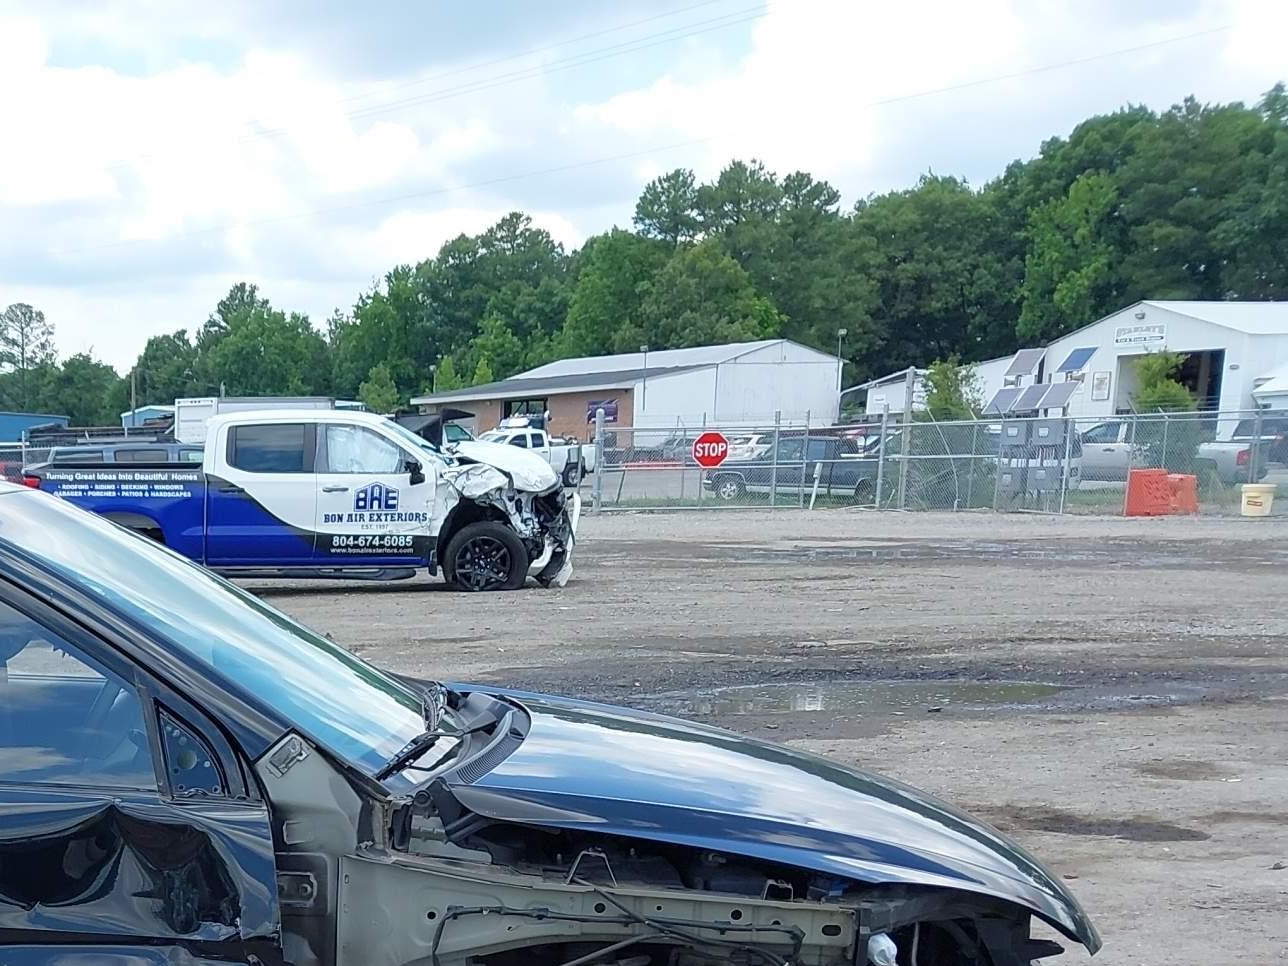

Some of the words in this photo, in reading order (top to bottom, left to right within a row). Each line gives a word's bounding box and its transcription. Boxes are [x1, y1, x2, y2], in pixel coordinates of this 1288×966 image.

[695, 443, 726, 457] STOP
[46, 472, 74, 481] Turning
[75, 472, 95, 480] Great
[97, 472, 117, 480] Ideas
[118, 472, 133, 480] Into
[134, 472, 168, 480] Beautiful
[172, 472, 198, 480] Homes
[355, 484, 398, 510] BAE
[324, 513, 344, 523] BON
[347, 513, 365, 522] AIR
[368, 512, 428, 522] EXTERIORS
[332, 535, 413, 547] 804-674-6085
